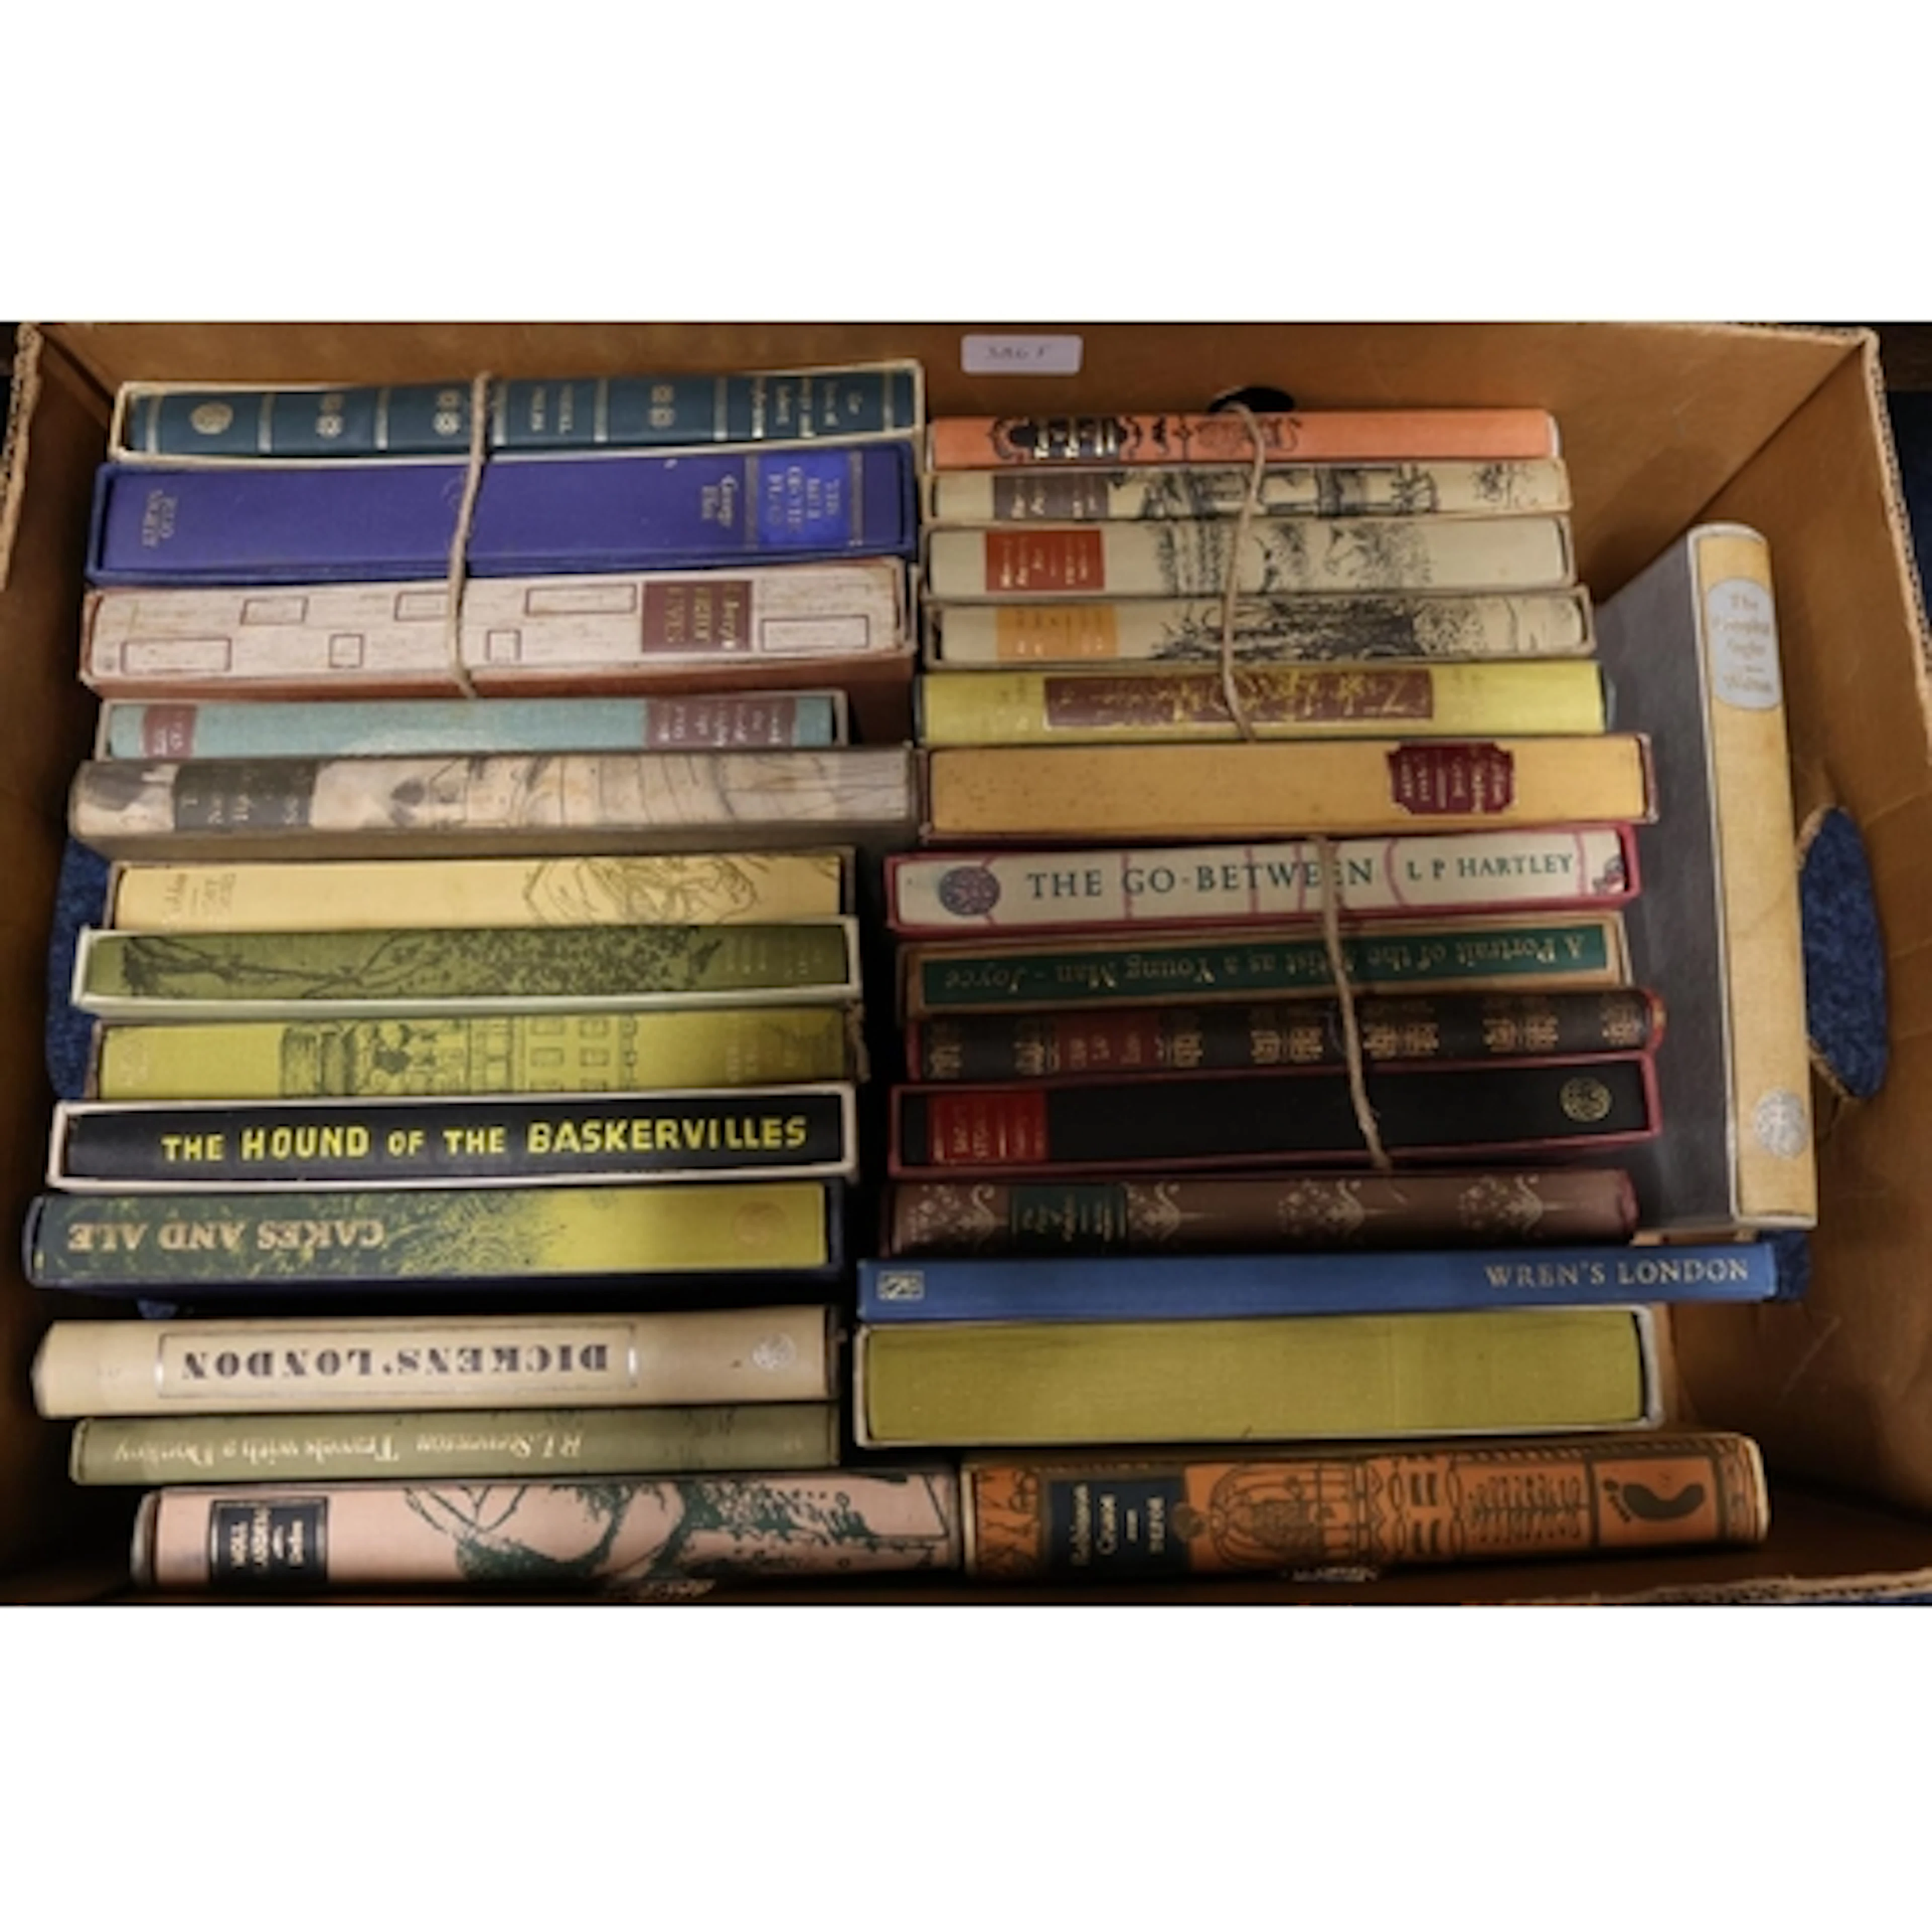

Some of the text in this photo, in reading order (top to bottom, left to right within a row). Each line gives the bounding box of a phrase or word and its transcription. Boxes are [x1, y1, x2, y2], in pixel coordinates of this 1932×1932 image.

[1027, 869, 1102, 900] THE
[1407, 860, 1422, 880] L
[1432, 859, 1445, 880] P
[1457, 853, 1573, 877] HARTLEY
[1369, 947, 1409, 972] the
[1416, 944, 1446, 971] of
[1458, 937, 1556, 968] Portrait
[1564, 935, 1584, 959] A
[945, 962, 1028, 993] Joyce
[1057, 960, 1117, 989] Man
[1125, 954, 1215, 985] Young
[162, 1116, 807, 1161] THE HOUND OF THE BASKERVILLES
[68, 1220, 386, 1251] CAKES AND ALE
[1484, 1258, 1748, 1288] WREN'S LONDON
[182, 1348, 373, 1380] LONDON
[242, 1437, 299, 1466] with
[305, 1434, 401, 1465] Travels
